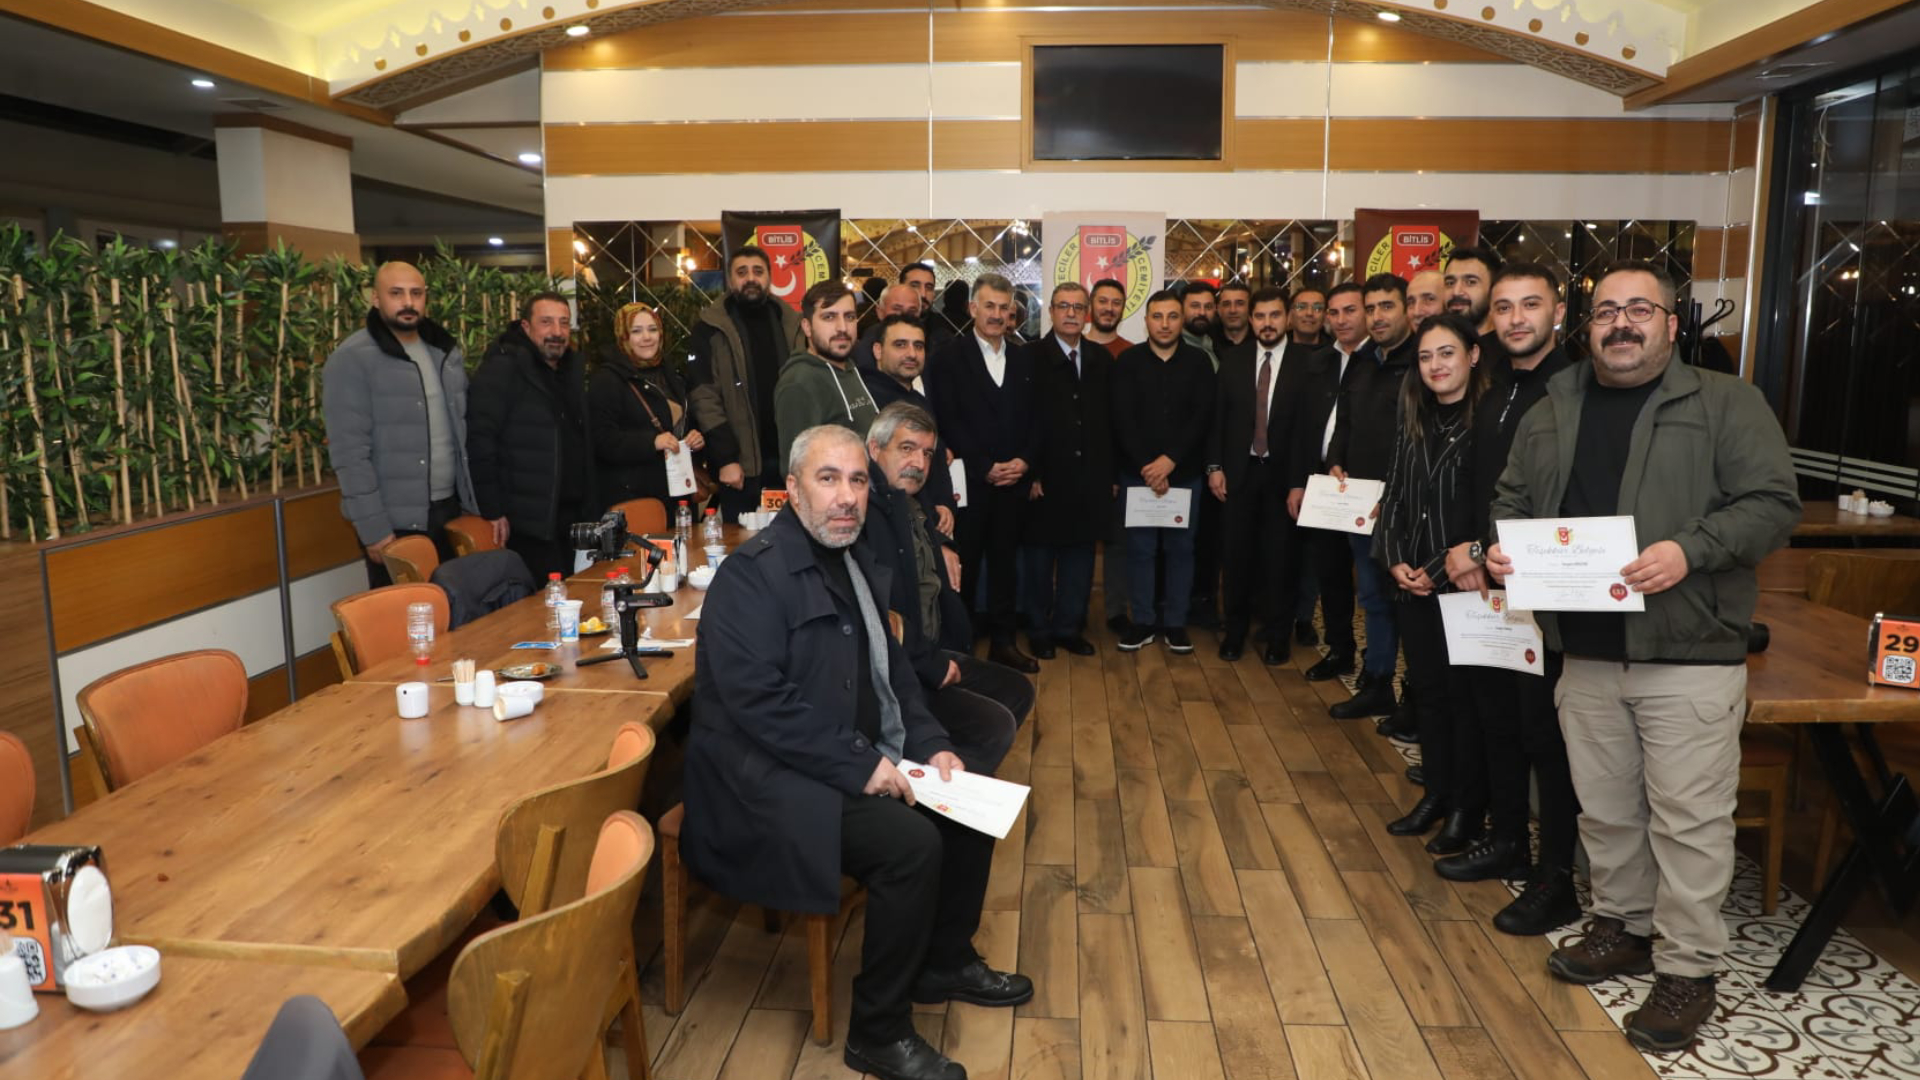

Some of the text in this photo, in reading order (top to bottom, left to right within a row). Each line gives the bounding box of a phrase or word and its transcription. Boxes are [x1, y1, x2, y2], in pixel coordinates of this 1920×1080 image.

[768, 233, 793, 243] BİTLİS
[1090, 236, 1116, 245] BİTLİS
[1403, 234, 1429, 243] BİTLİS
[766, 498, 782, 508] 30
[1885, 634, 1919, 653] 29
[0, 900, 35, 930] 31
